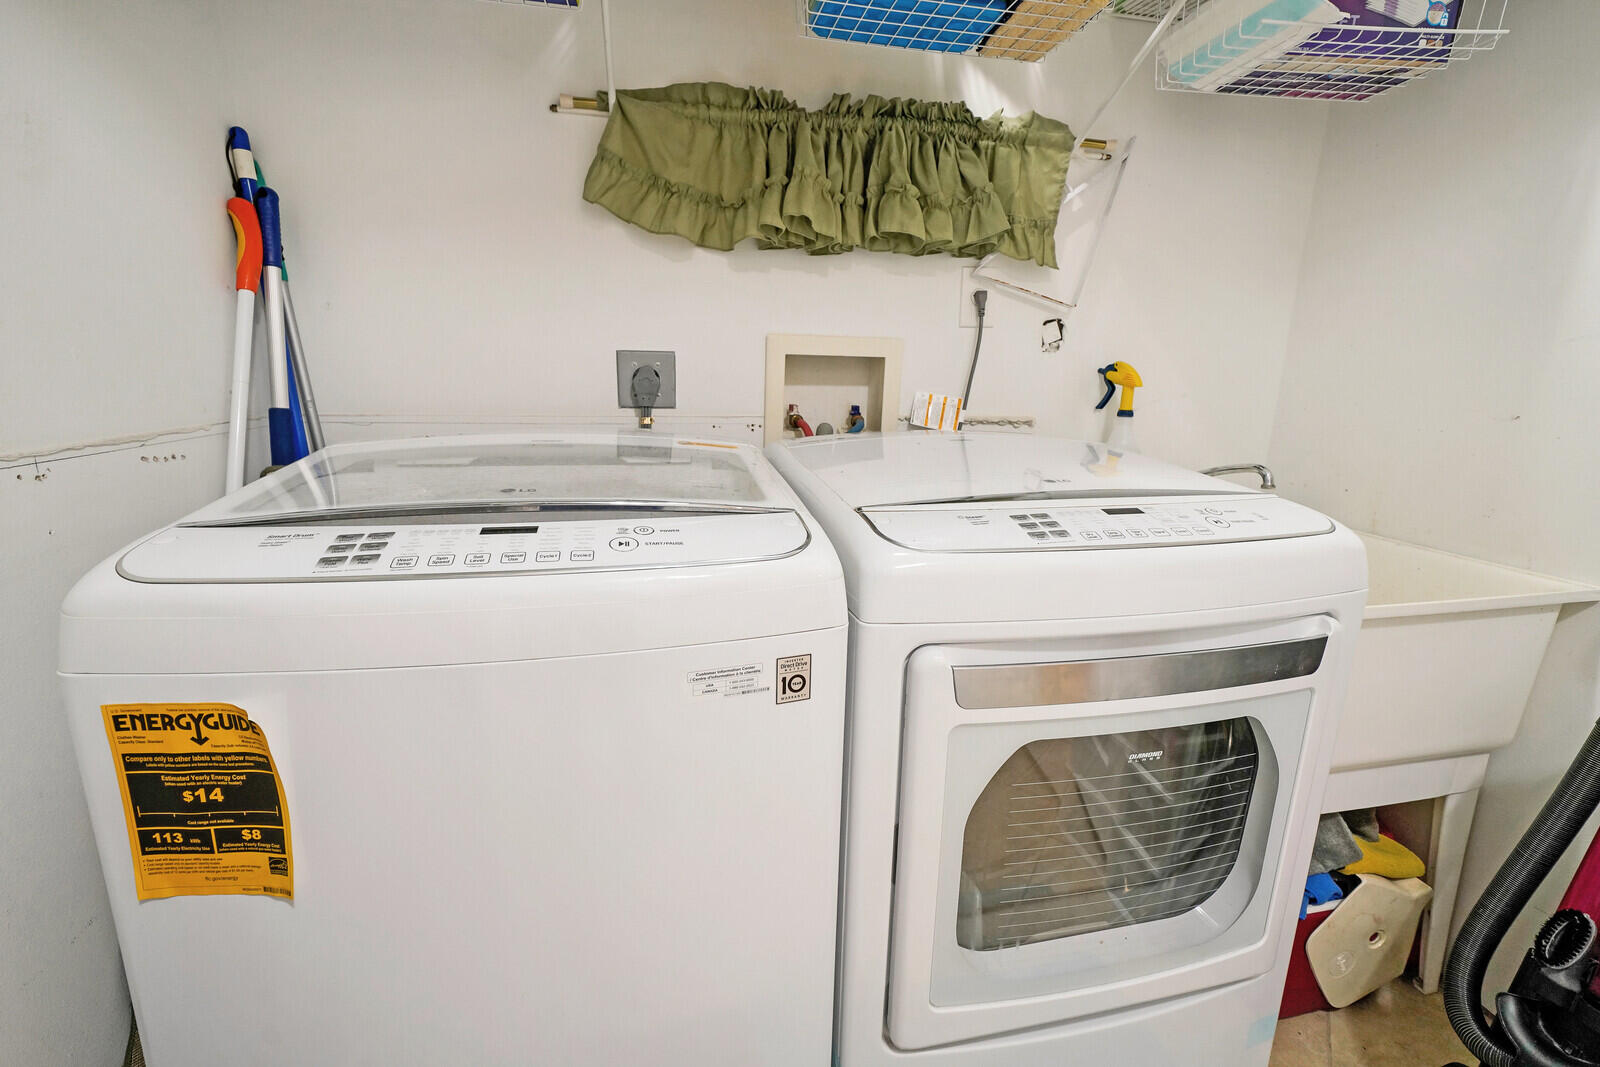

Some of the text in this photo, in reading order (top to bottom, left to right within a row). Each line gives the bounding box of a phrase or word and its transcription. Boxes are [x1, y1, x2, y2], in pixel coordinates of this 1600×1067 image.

[695, 669, 717, 677] Customer
[716, 666, 741, 674] Information
[780, 662, 795, 670] Direct
[781, 673, 807, 695] 10
[112, 713, 260, 736] ENERGYGUIDE
[125, 755, 153, 763] Compare
[153, 755, 167, 763] only
[223, 754, 244, 762] yellow
[1128, 750, 1163, 760] DIAMOND
[182, 787, 225, 803] $14
[152, 832, 184, 844] 113
[241, 828, 262, 841] $8
